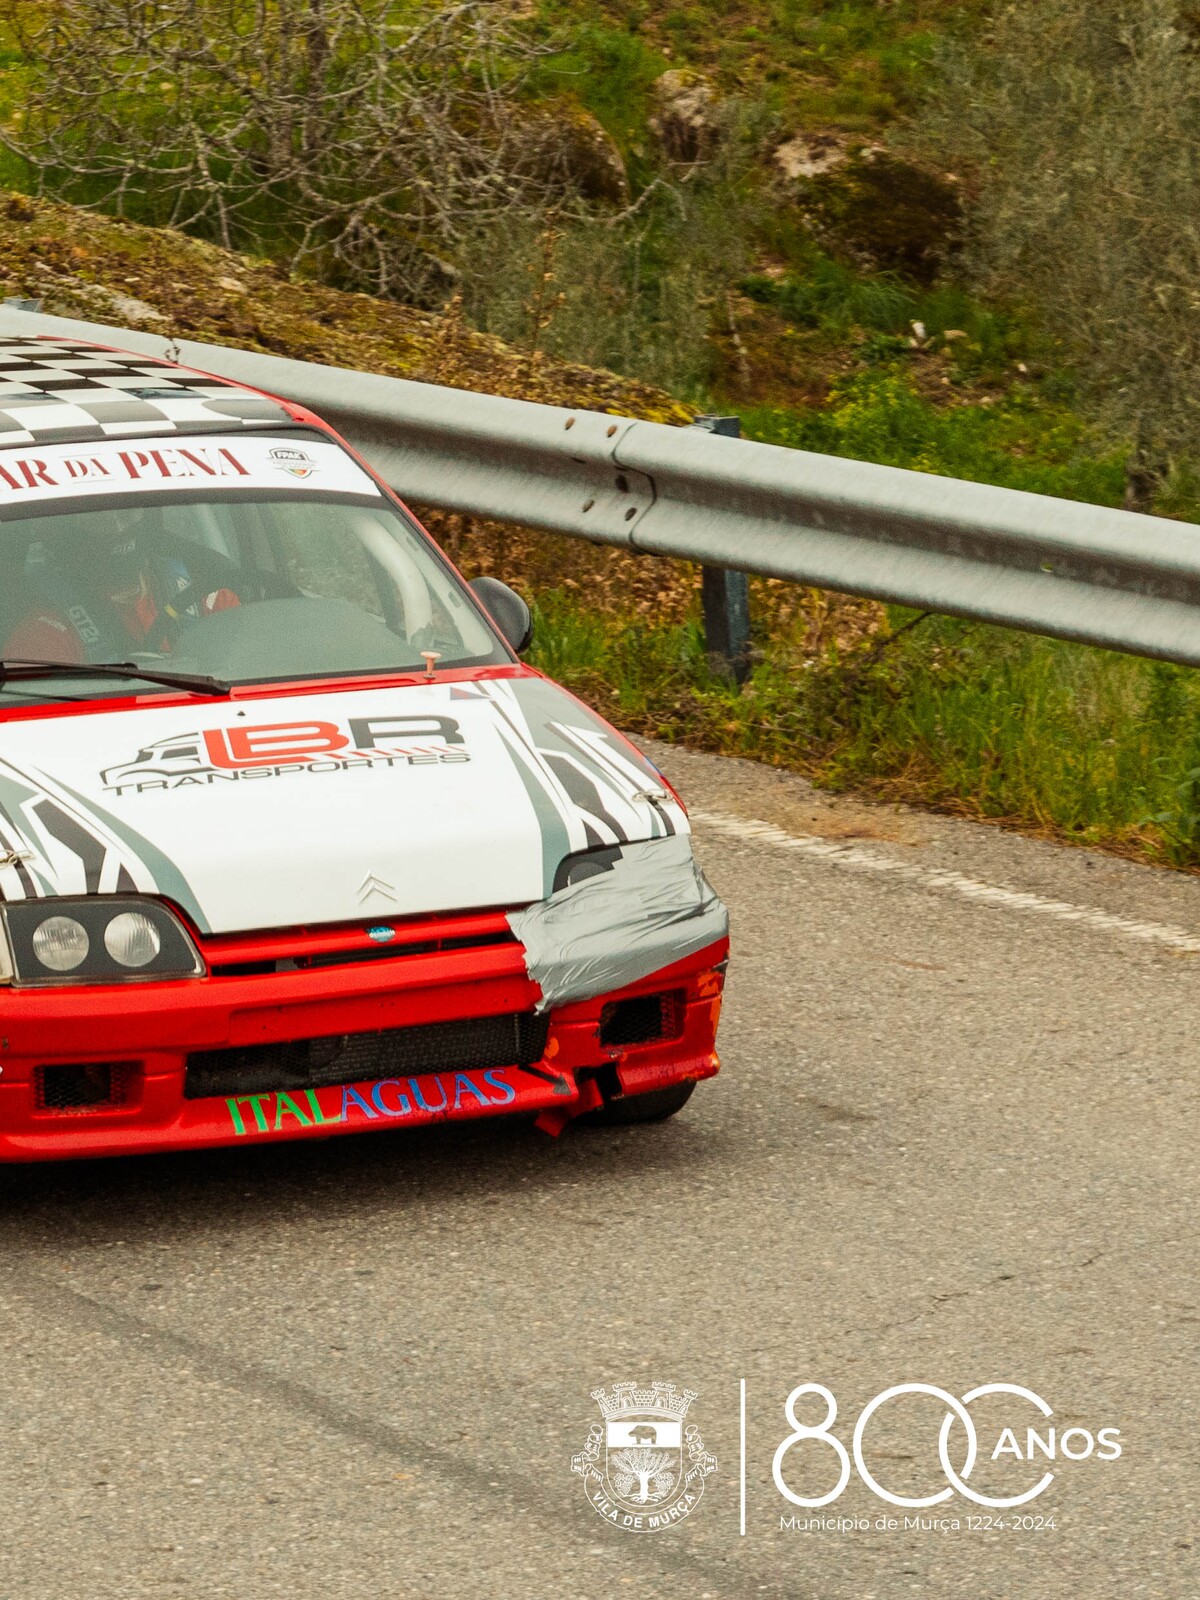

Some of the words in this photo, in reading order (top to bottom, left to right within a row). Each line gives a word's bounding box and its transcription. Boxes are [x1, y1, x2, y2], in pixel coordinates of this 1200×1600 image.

[64, 457, 111, 479] DA
[117, 447, 251, 480] PENA
[274, 450, 302, 460] FPAK
[202, 715, 465, 769] LBR
[102, 752, 472, 796] TRANSPORTES
